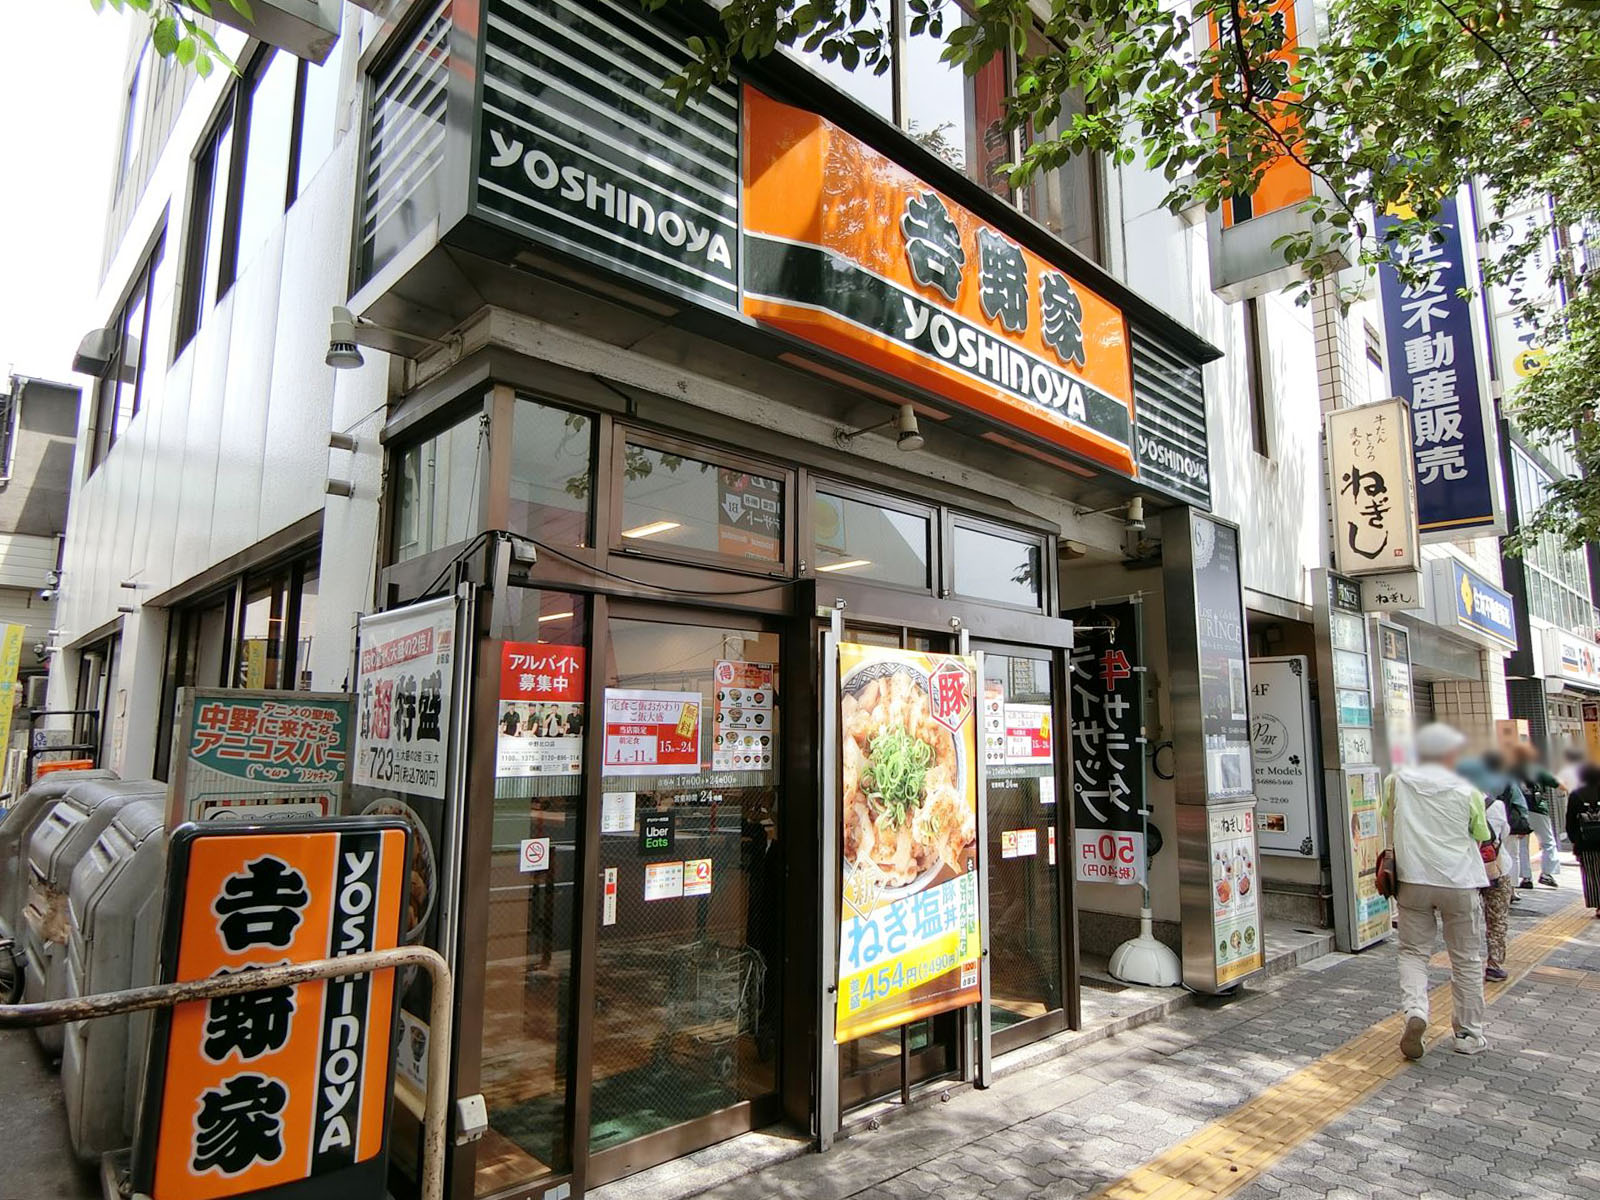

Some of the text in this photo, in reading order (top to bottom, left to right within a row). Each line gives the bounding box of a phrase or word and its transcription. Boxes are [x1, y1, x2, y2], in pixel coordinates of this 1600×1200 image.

[489, 128, 732, 270] YOSHINOYA
[901, 191, 1086, 368] 吉野家
[903, 297, 1087, 422] YOSHINOYA
[1139, 435, 1208, 484] YOSHINOYA
[1341, 465, 1392, 560] ねぎし
[1375, 592, 1412, 605] ねぎし
[509, 653, 580, 676] アルバイト
[519, 673, 569, 693] 募集中
[611, 700, 680, 712] 定食ご飯おかわり
[938, 671, 968, 718] 豚
[199, 703, 340, 745] 中野に来たなら
[1268, 766, 1303, 777] Models
[645, 837, 669, 849] Eats
[646, 826, 669, 838] Uber
[1220, 815, 1244, 833] ねぎし
[848, 890, 944, 968] ねぎ塩
[190, 857, 310, 1176] 吉野家
